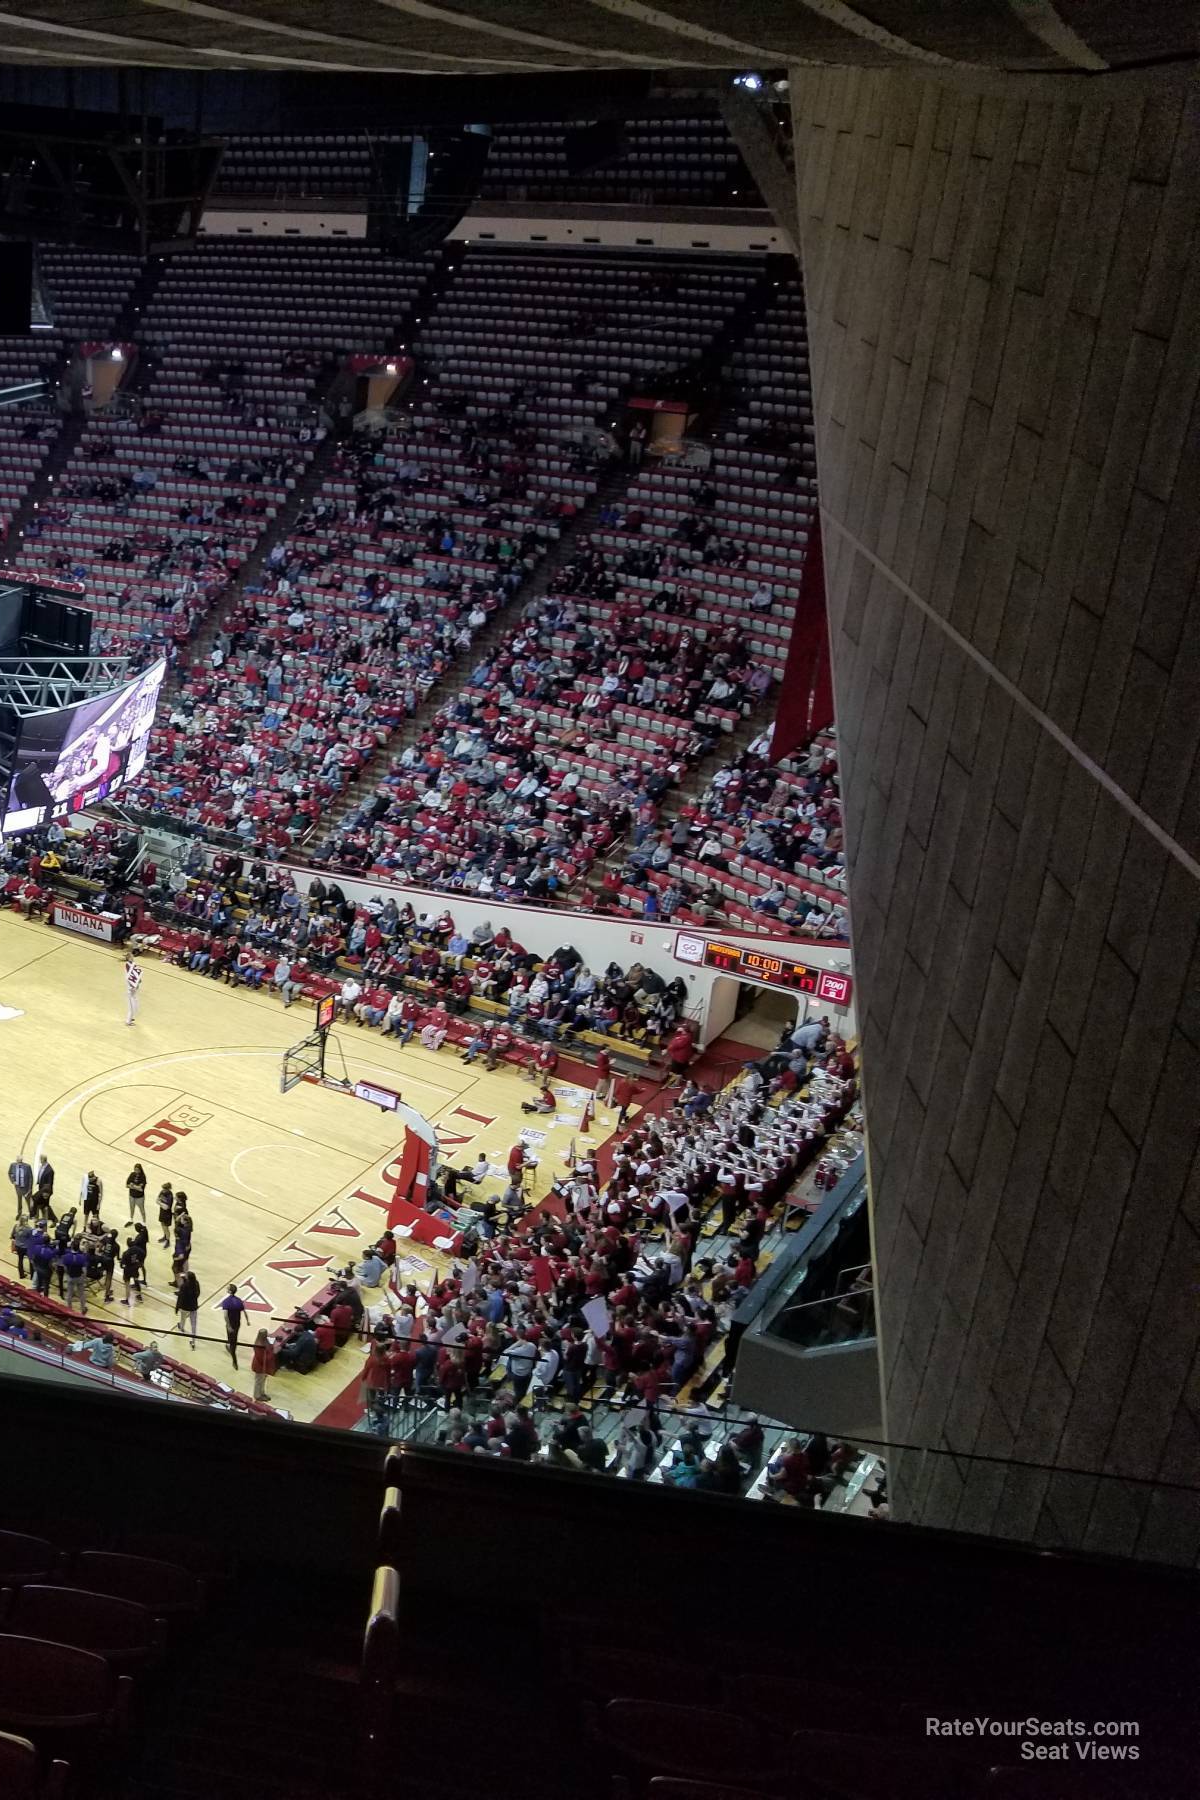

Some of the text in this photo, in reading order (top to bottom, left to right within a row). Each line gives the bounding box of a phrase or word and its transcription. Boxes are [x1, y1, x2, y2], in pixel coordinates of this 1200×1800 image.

[51, 802, 68, 819] 11
[61, 909, 104, 932] INDIANA
[715, 955, 729, 969] 11
[748, 955, 780, 972] 10:00
[825, 979, 843, 990] 200
